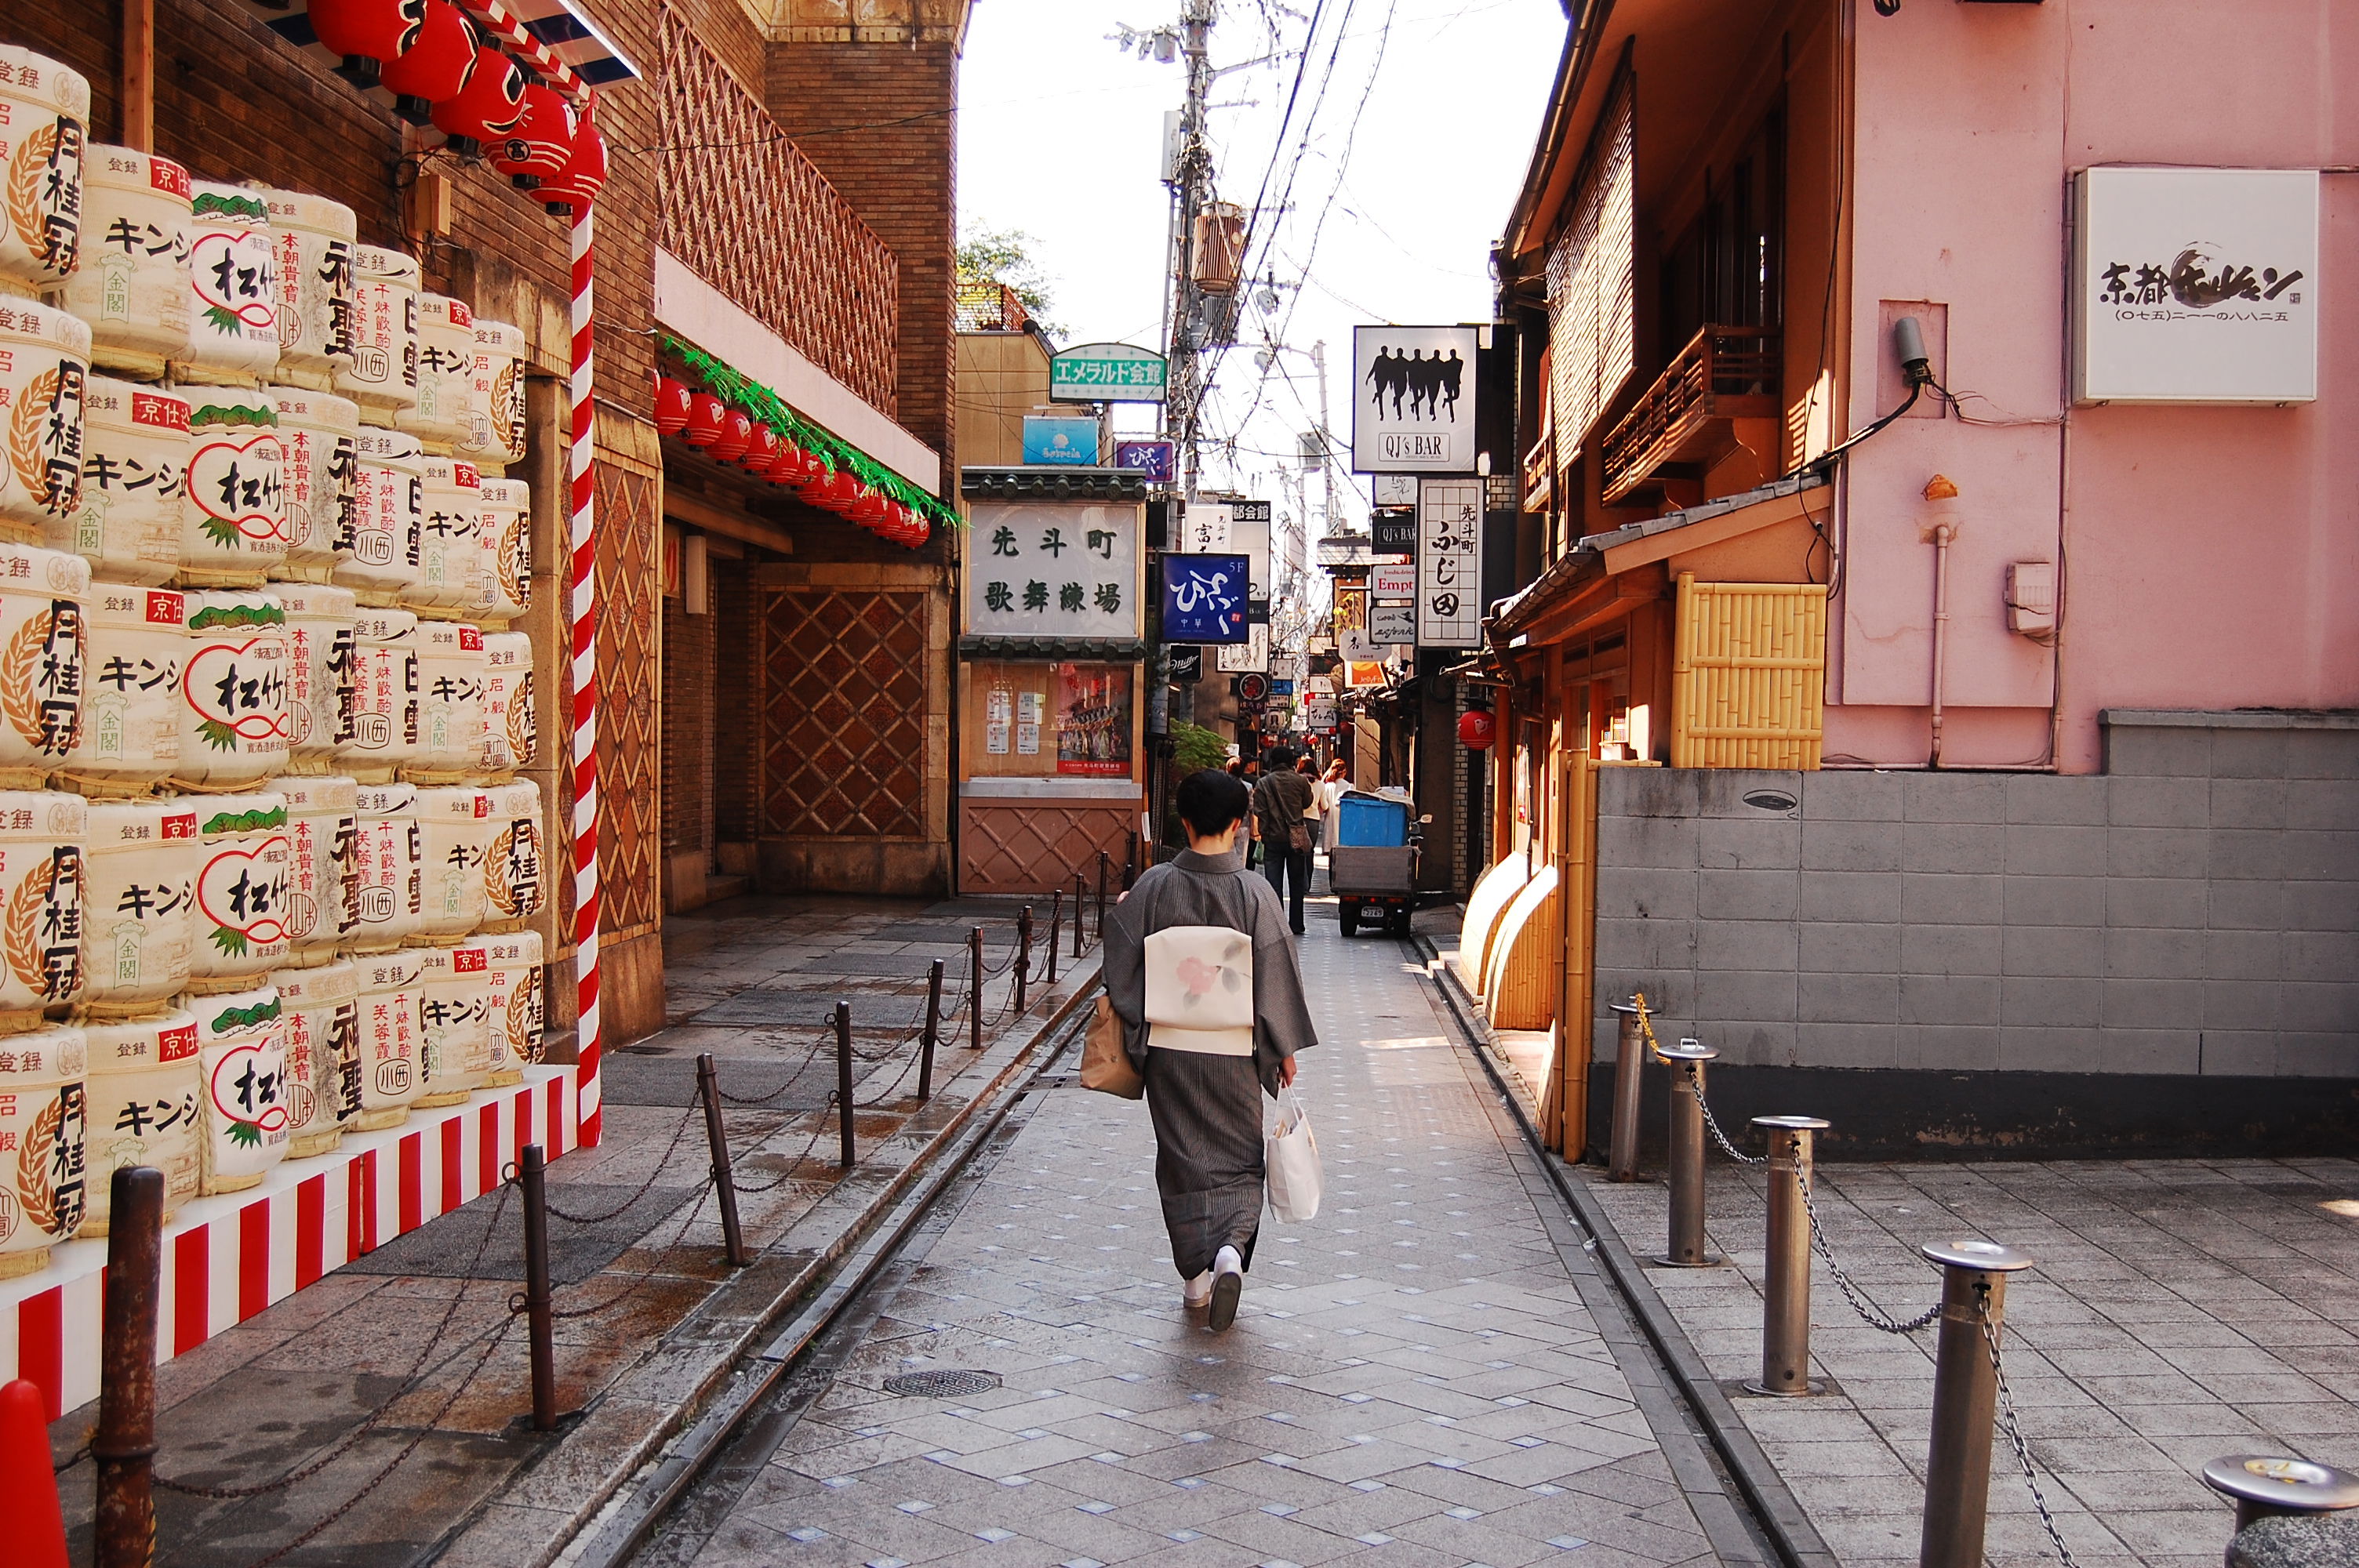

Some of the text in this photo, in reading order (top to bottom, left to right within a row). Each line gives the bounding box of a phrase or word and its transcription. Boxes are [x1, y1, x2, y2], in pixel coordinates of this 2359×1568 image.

[108, 158, 139, 174] 登録
[155, 163, 191, 196] 京仕
[40, 115, 83, 276] 月桂冠
[1056, 361, 1162, 383] エメラルド会館
[87, 395, 118, 411] 登録
[39, 359, 84, 519] 月桂冠
[1415, 436, 1441, 455] BAR
[1233, 505, 1268, 520] 都会館
[1460, 505, 1476, 554] 先斗町
[992, 525, 1117, 559] 先斗町
[1431, 521, 1459, 617] ふじ田
[105, 597, 135, 611] 登録
[985, 579, 1121, 613] 歌舞練場
[35, 599, 80, 757] 月桂冠
[120, 825, 151, 840] 登録
[508, 818, 539, 917] 月桂冠
[41, 846, 81, 1002] 月桂冠
[117, 1042, 147, 1057] 登録
[51, 1082, 85, 1237] 月桂冠
